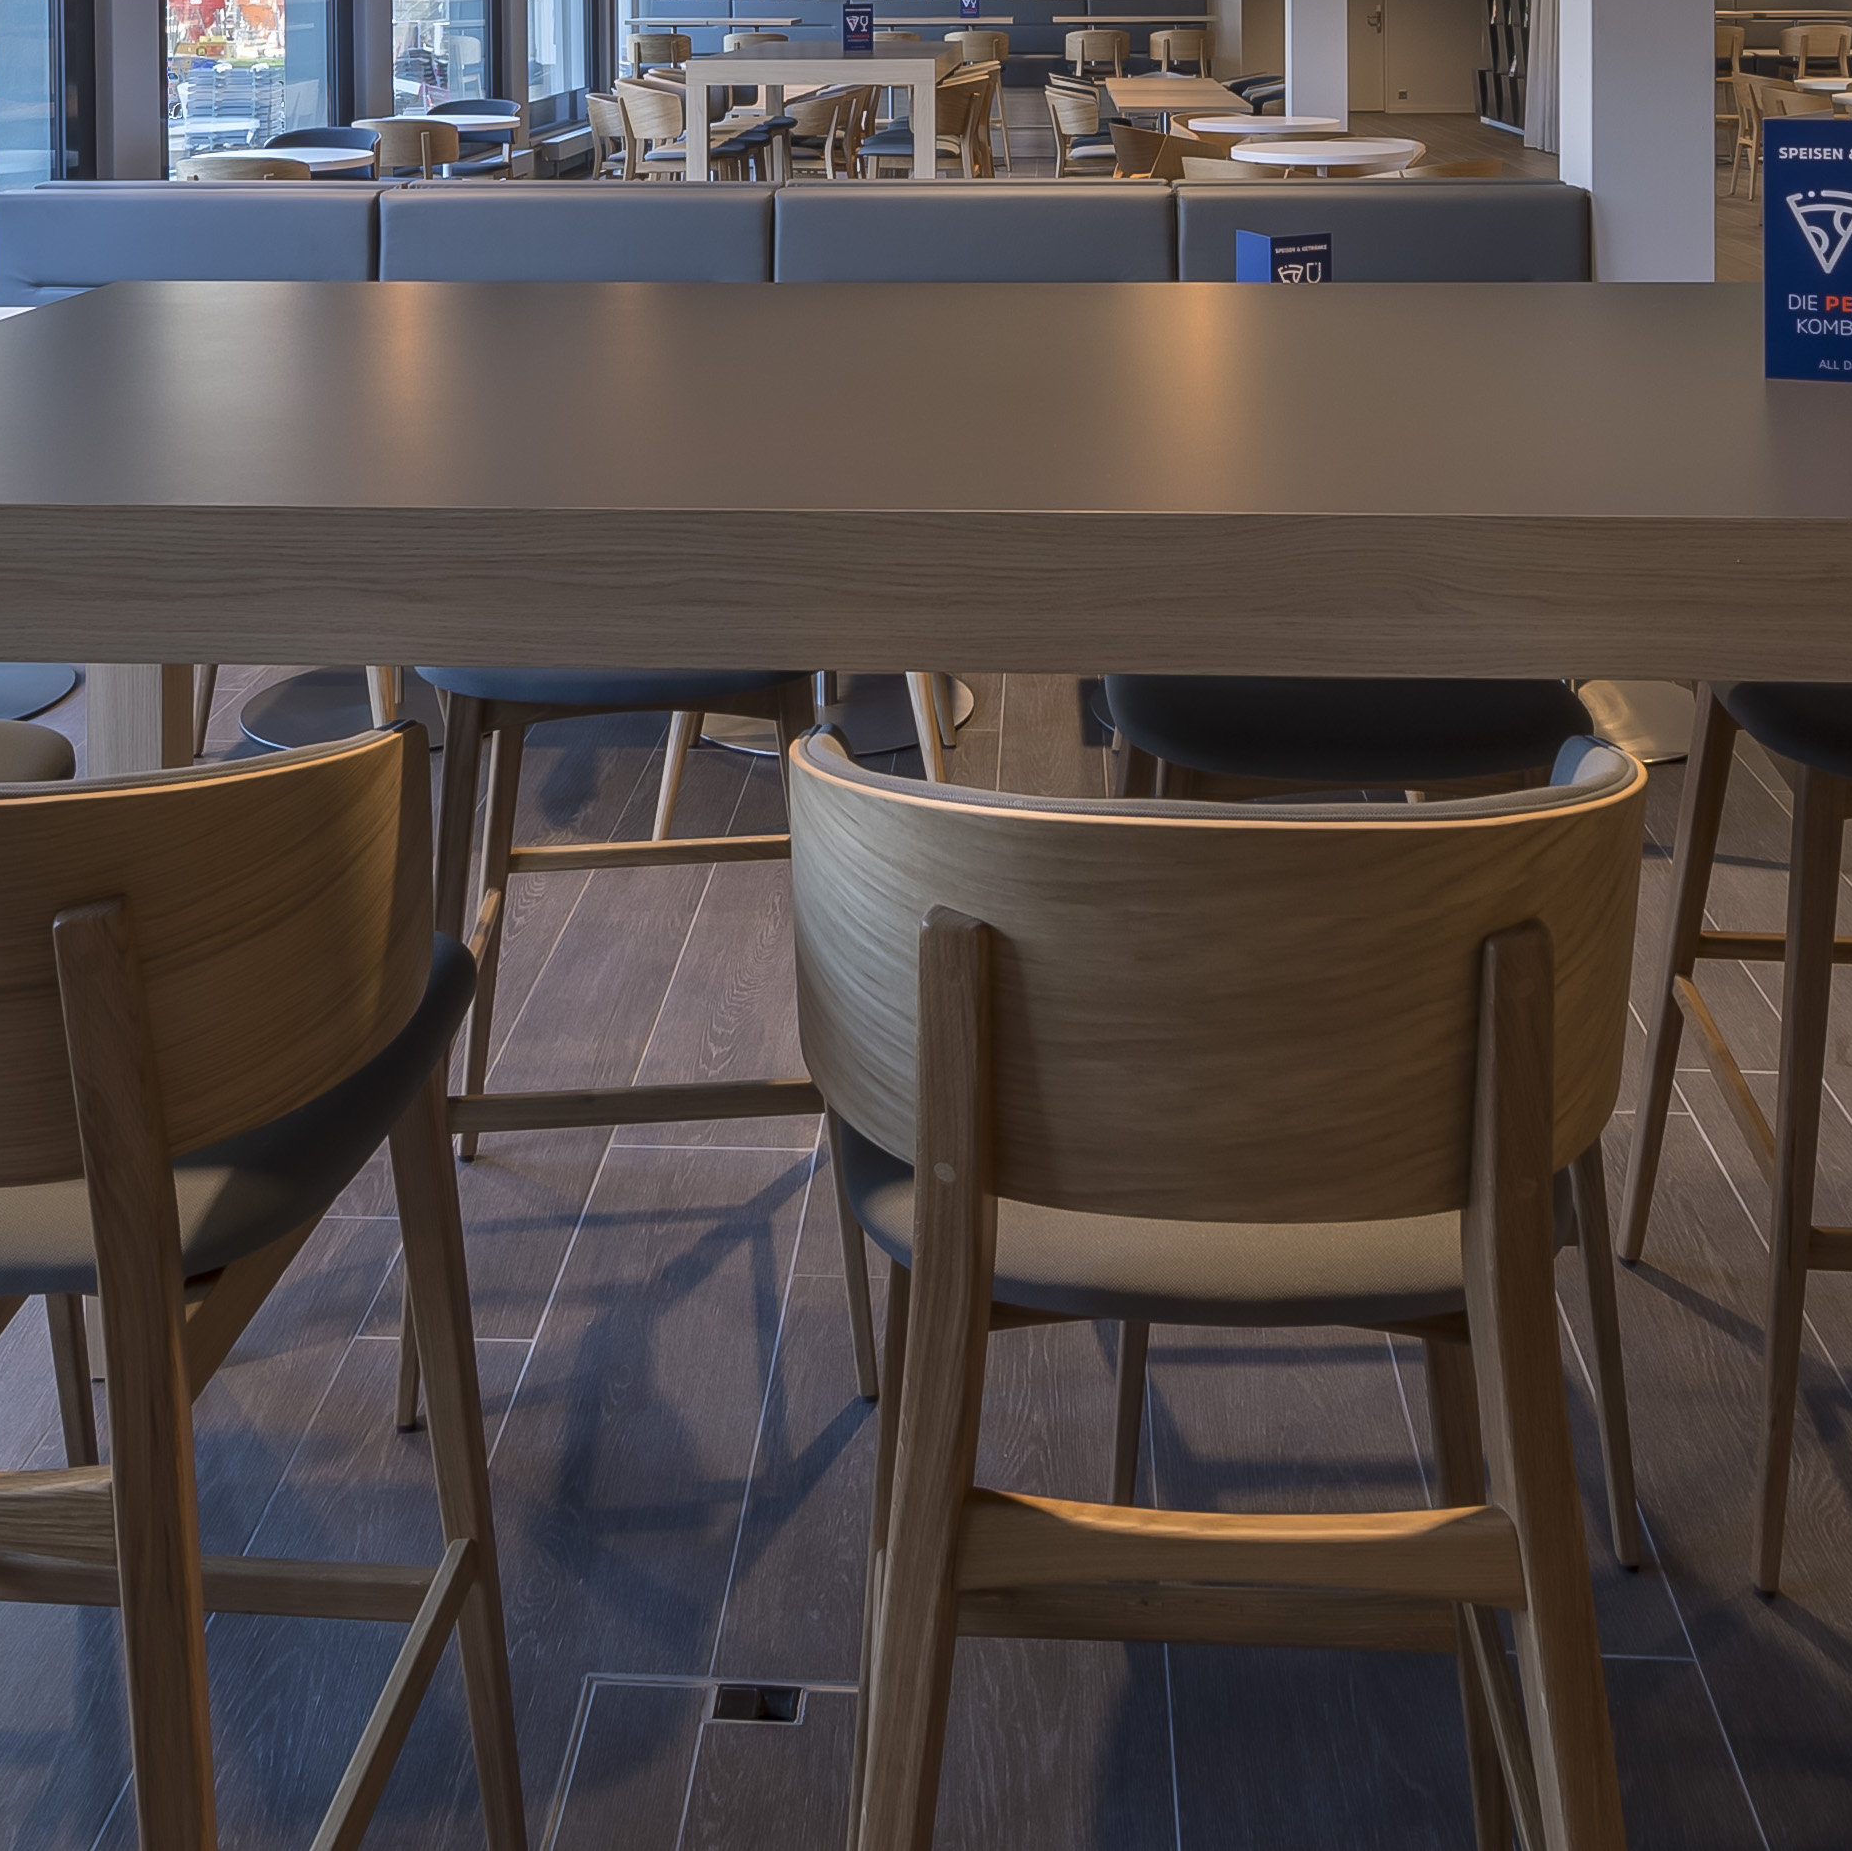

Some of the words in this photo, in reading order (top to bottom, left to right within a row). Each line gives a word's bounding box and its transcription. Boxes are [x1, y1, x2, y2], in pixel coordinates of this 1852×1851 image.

[1779, 147, 1843, 160] SPEISEN
[1788, 294, 1818, 311] DIE
[1819, 359, 1840, 370] ALL
